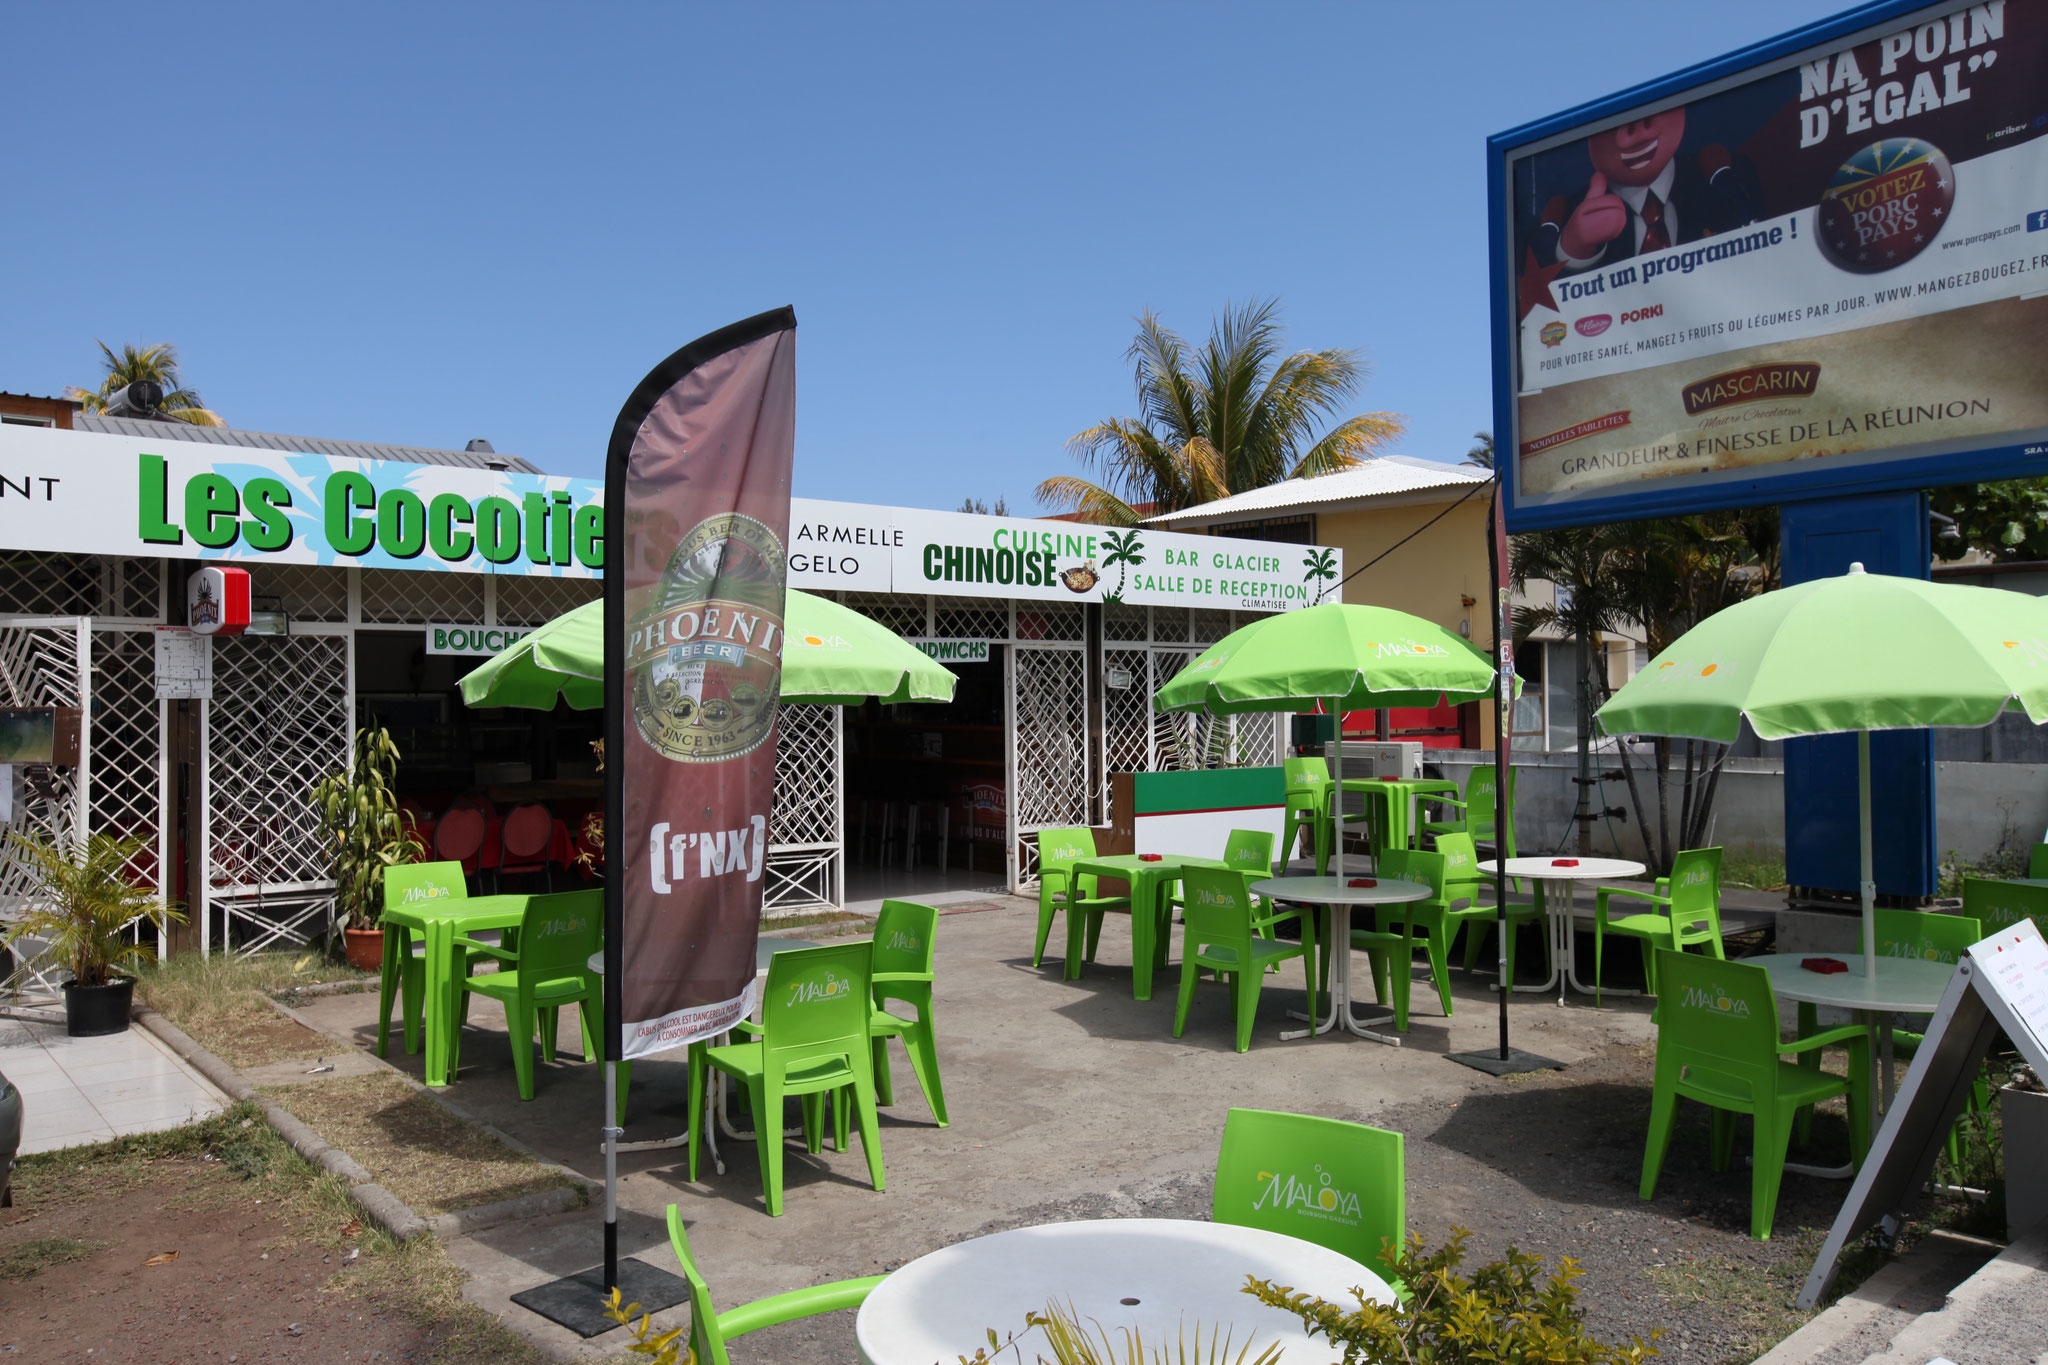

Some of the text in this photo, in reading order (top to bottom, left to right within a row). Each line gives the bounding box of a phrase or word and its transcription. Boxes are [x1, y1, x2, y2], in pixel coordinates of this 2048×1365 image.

[1800, 2, 2006, 102] NA POIN
[1842, 169, 1927, 214] VOTEZ
[1852, 192, 1919, 232] PORC
[1858, 211, 1919, 248] PAYS
[1941, 223, 2021, 251] www.porcpays.com
[1558, 275, 1606, 302] Tout
[1609, 265, 1638, 290] un
[1641, 223, 1784, 284] programme
[1540, 253, 2048, 372] POUR VOTRE SANTÉ, MANGEZ 5 FRUITS OU LÉGUMES PAR JOUR. WWW.MANGEZBOUGEZ.FR
[1620, 303, 1664, 326] PORKI
[1691, 370, 1811, 410] MASCARIN
[1529, 414, 1625, 451] NOUVELLES TABLETTES
[1561, 397, 1991, 475] GRANDEUR & FINESSE DE LA RÉUNION
[2024, 446, 2043, 456] SRA
[138, 452, 293, 553] Les
[709, 520, 740, 540] BEER
[744, 526, 764, 545] OF
[796, 523, 904, 547] ARMELLE
[992, 528, 1098, 560] CUISINE
[923, 543, 1058, 588] CHINOISE
[1164, 548, 1281, 574] BAR GLACIER
[1133, 573, 1308, 601] SALLE DE RECEPTION
[192, 602, 218, 622] PHOENIX
[1241, 597, 1288, 611] CLIMATISEE
[626, 608, 784, 660] PHOENI
[681, 643, 732, 658] BEER
[1368, 642, 1450, 659] MALOYA
[662, 726, 737, 747] SINCE 1963
[1051, 847, 1086, 862] MALOYA
[402, 886, 450, 905] MALOYA
[1197, 889, 1236, 905] MALOYA
[536, 918, 588, 940] MALOYA
[787, 978, 850, 1008] MALOYA
[1680, 984, 1751, 1016] MALOYA
[637, 1024, 656, 1038] L'ABUS
[656, 1017, 682, 1033] D'ALCOOL
[682, 1014, 692, 1024] EST
[692, 1007, 726, 1023] DANGEREUX
[725, 1002, 738, 1014] POUR
[661, 1025, 698, 1041] CONSOMMER
[699, 1022, 712, 1033] AVEC
[1252, 1170, 1363, 1220] MALOYA
[1297, 1208, 1359, 1227] BOISSON GAZEUSE
